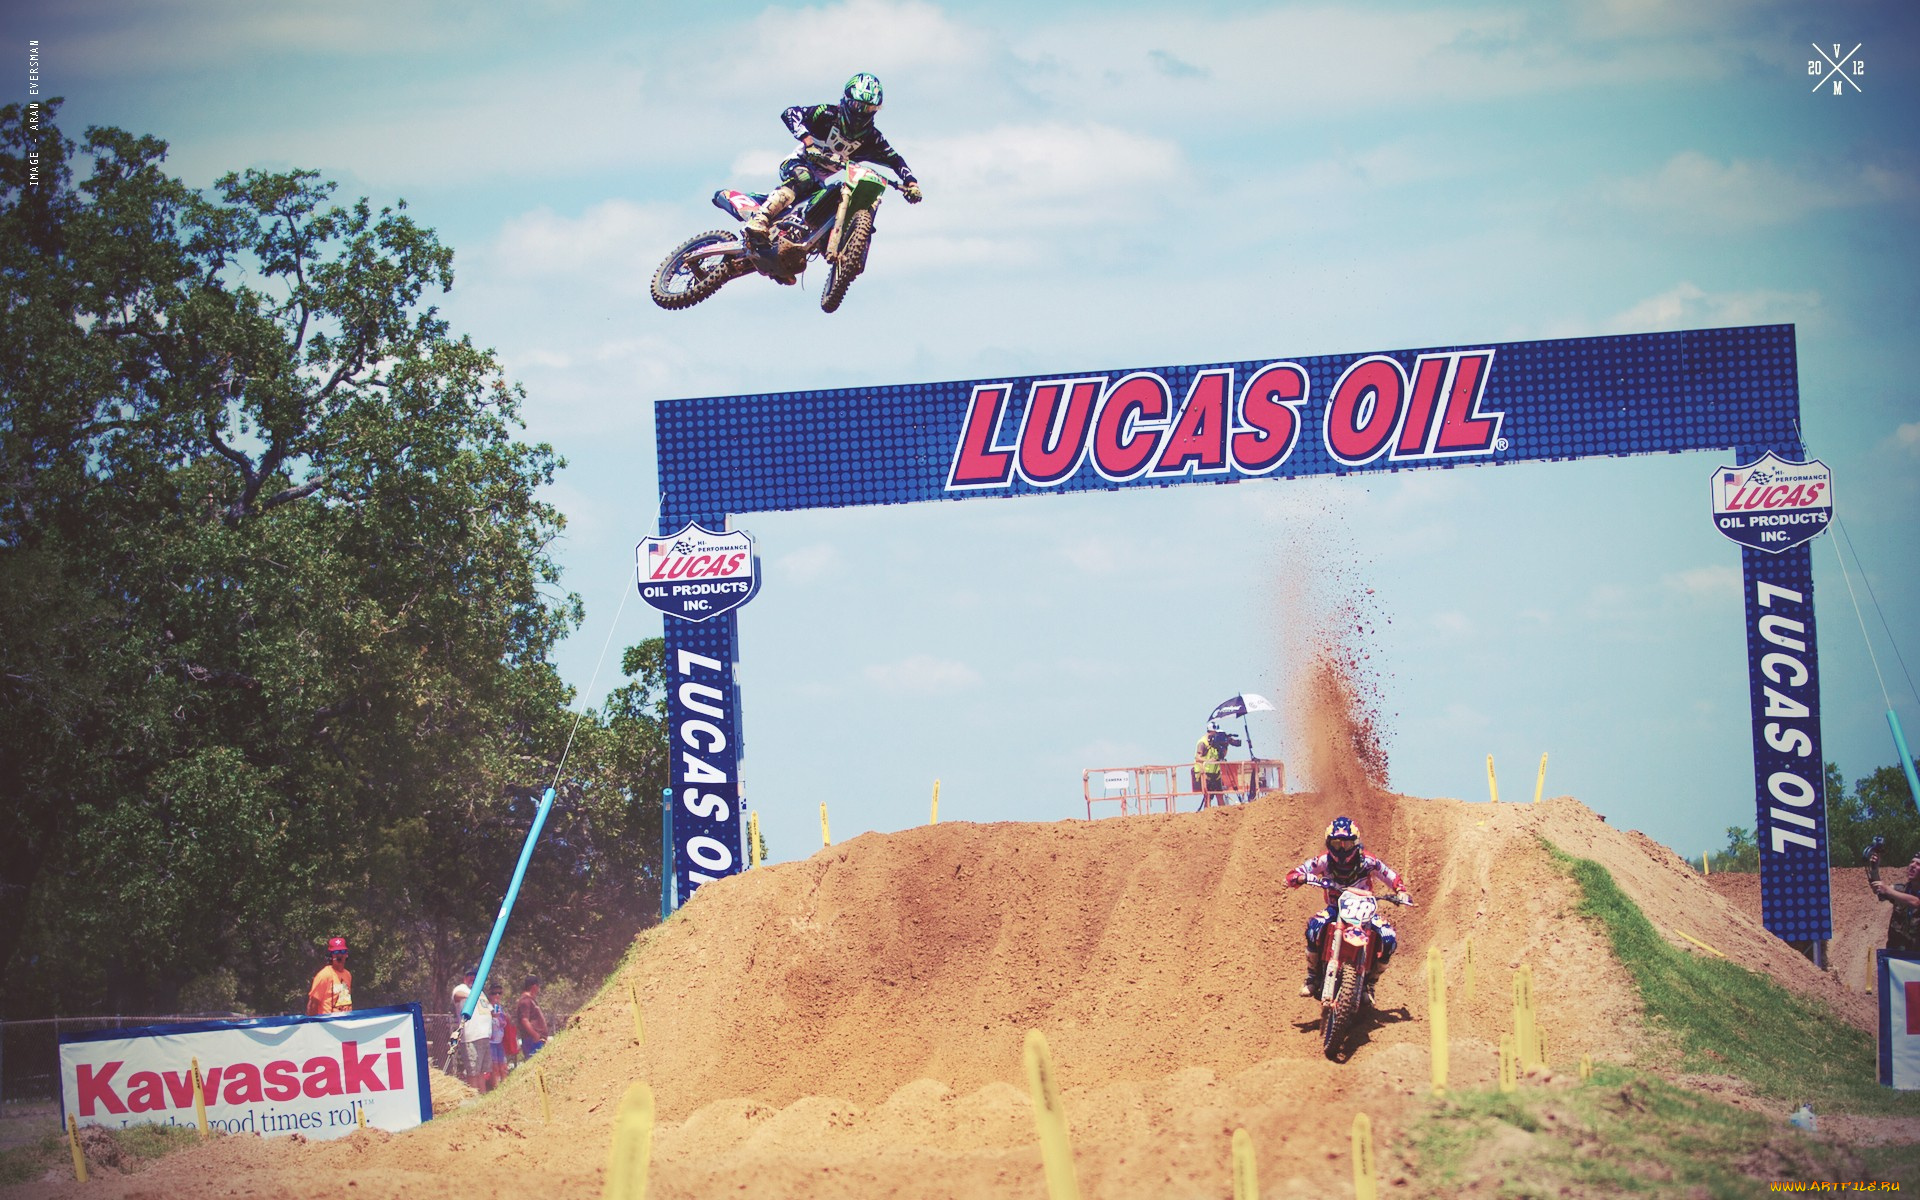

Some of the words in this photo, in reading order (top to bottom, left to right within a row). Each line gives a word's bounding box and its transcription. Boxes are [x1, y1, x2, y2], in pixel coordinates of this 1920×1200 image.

[944, 361, 1311, 491] LUCAS
[1775, 474, 1828, 482] PERFORMANCE
[1725, 483, 1826, 511] LUCAS
[1719, 517, 1746, 529] OIL
[1749, 512, 1828, 527] PRODUCTS
[1760, 530, 1791, 543] INC.
[650, 553, 746, 579] LUCAS
[643, 586, 669, 598] OIL
[672, 582, 749, 597] PRODUCTS
[683, 599, 713, 611] INC.
[1756, 580, 1813, 758] LUCAS
[677, 648, 730, 822] LUCAS
[1767, 771, 1818, 854] OIL
[1340, 898, 1376, 920] 38
[75, 1037, 405, 1117] Kawasaki
[262, 1108, 323, 1134] times
